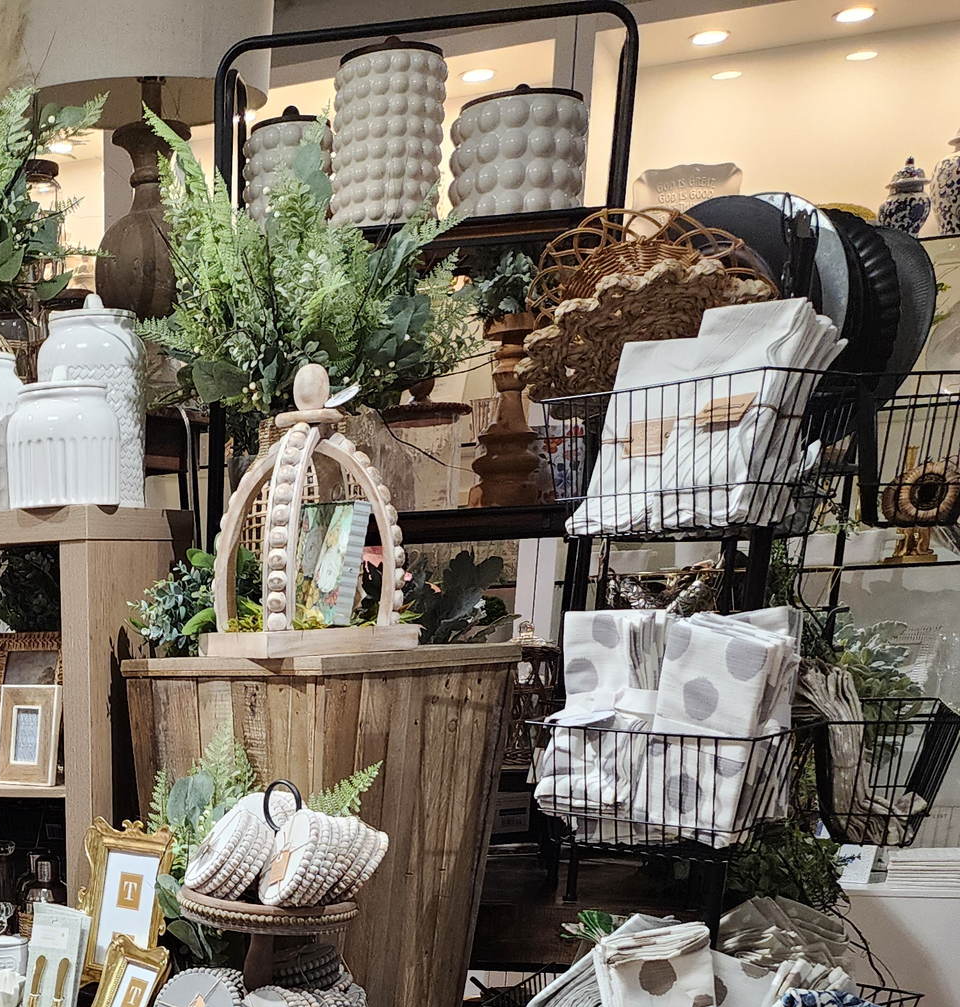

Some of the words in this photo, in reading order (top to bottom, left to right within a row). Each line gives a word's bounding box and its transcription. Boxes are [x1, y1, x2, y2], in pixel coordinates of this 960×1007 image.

[678, 178, 686, 189] IS
[688, 176, 717, 189] GREAT
[658, 193, 677, 203] GOD
[678, 191, 688, 200] IS
[123, 881, 137, 901] T
[127, 986, 142, 1005] T
